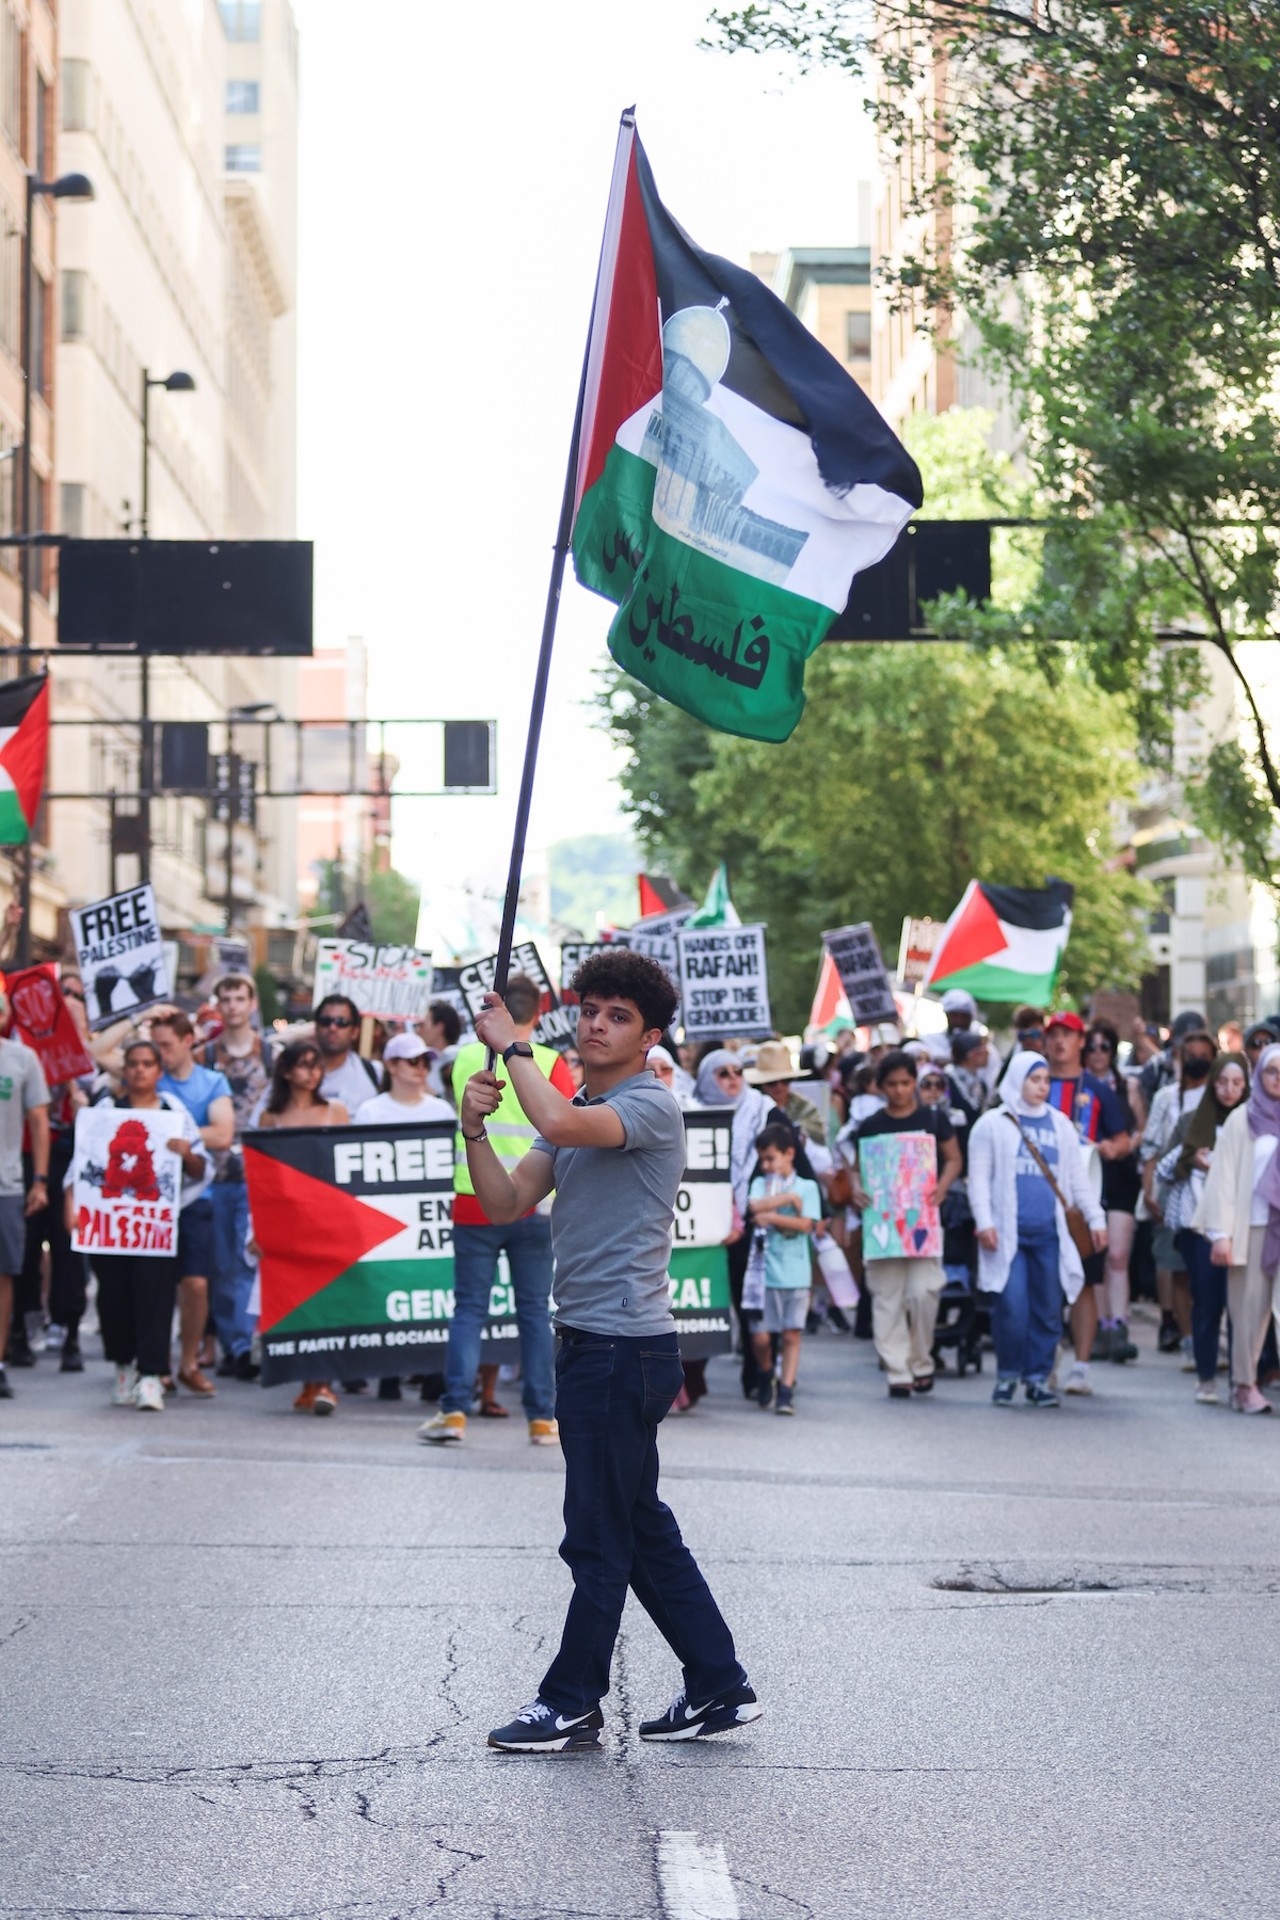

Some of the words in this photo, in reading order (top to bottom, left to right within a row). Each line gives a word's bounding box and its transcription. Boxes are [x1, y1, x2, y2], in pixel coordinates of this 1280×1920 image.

[80, 891, 151, 946] FREE
[79, 925, 157, 968] PALESTINE
[684, 937, 731, 953] HANDS
[734, 934, 758, 950] OFF
[686, 954, 759, 979] RAFAH!
[691, 988, 728, 1006] STOP
[733, 986, 758, 1003] THE
[333, 1138, 455, 1184] FREE
[267, 1341, 295, 1357] THE
[299, 1335, 347, 1354] PARTY
[350, 1332, 382, 1349] FOR
